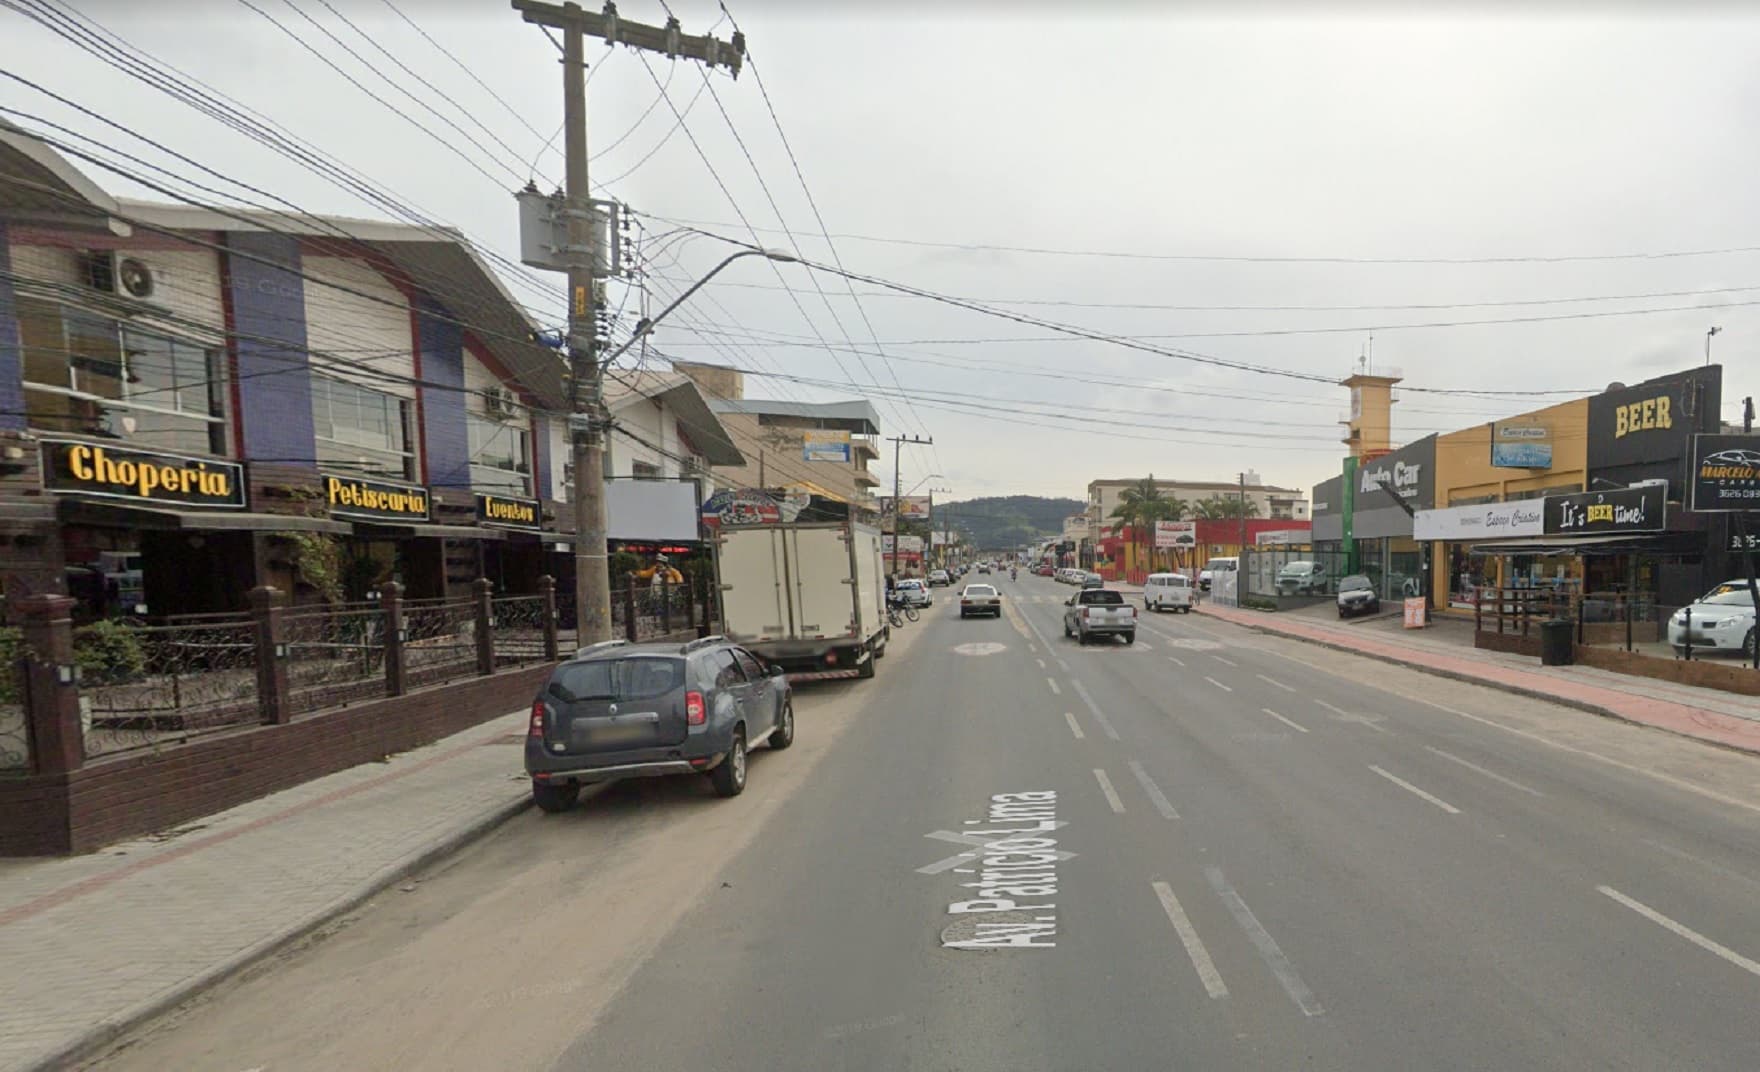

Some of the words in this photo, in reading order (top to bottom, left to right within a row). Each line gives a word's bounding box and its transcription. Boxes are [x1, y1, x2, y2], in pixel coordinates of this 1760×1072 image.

[1615, 395, 1672, 439] BEER
[69, 444, 232, 497] Choperia
[1360, 465, 1392, 493] Auto
[1394, 460, 1421, 488] Car
[1700, 465, 1754, 479] MARCELO
[328, 476, 426, 513] Petiscaria
[485, 496, 534, 522] Eventos
[1586, 504, 1614, 523] BEER
[1614, 495, 1646, 524] time!
